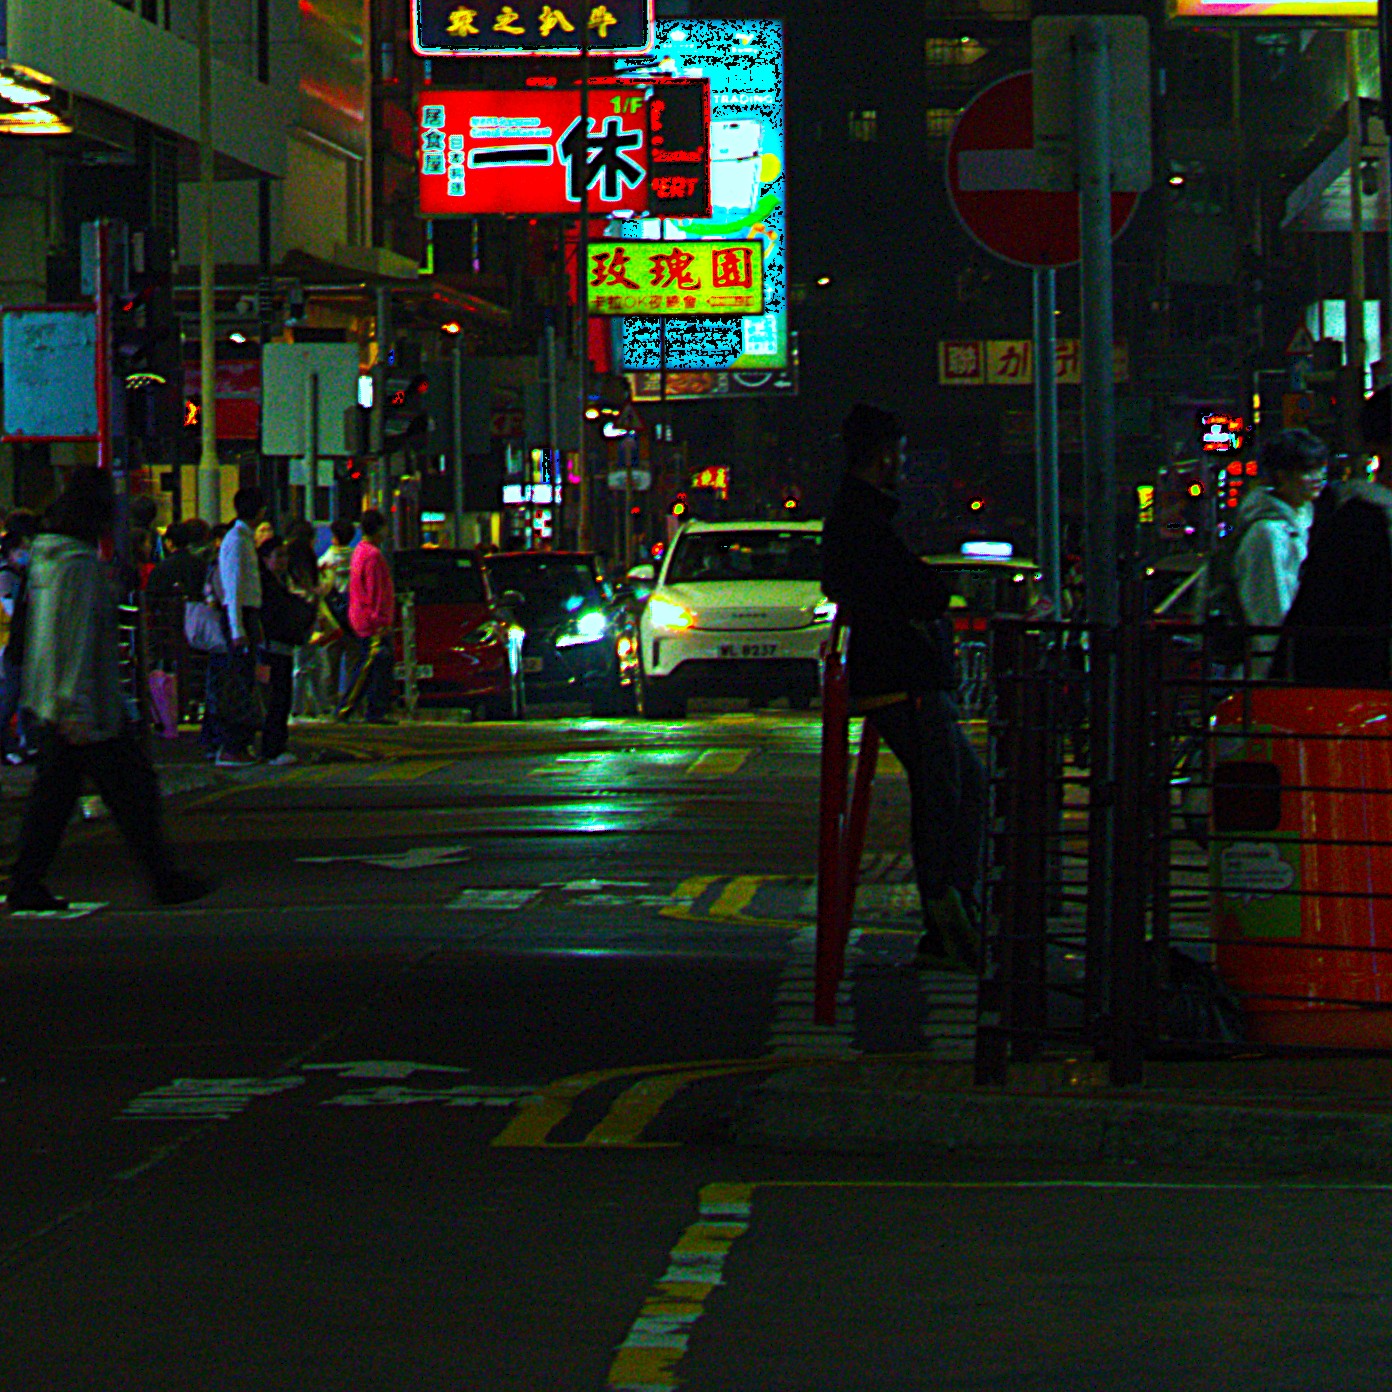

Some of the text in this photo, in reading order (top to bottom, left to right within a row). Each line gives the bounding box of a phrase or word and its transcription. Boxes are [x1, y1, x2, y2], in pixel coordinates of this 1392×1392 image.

[610, 95, 644, 114] 1/F
[713, 94, 773, 104] TRADING
[468, 115, 646, 202] 一休
[590, 246, 754, 291] 玫瑰園
